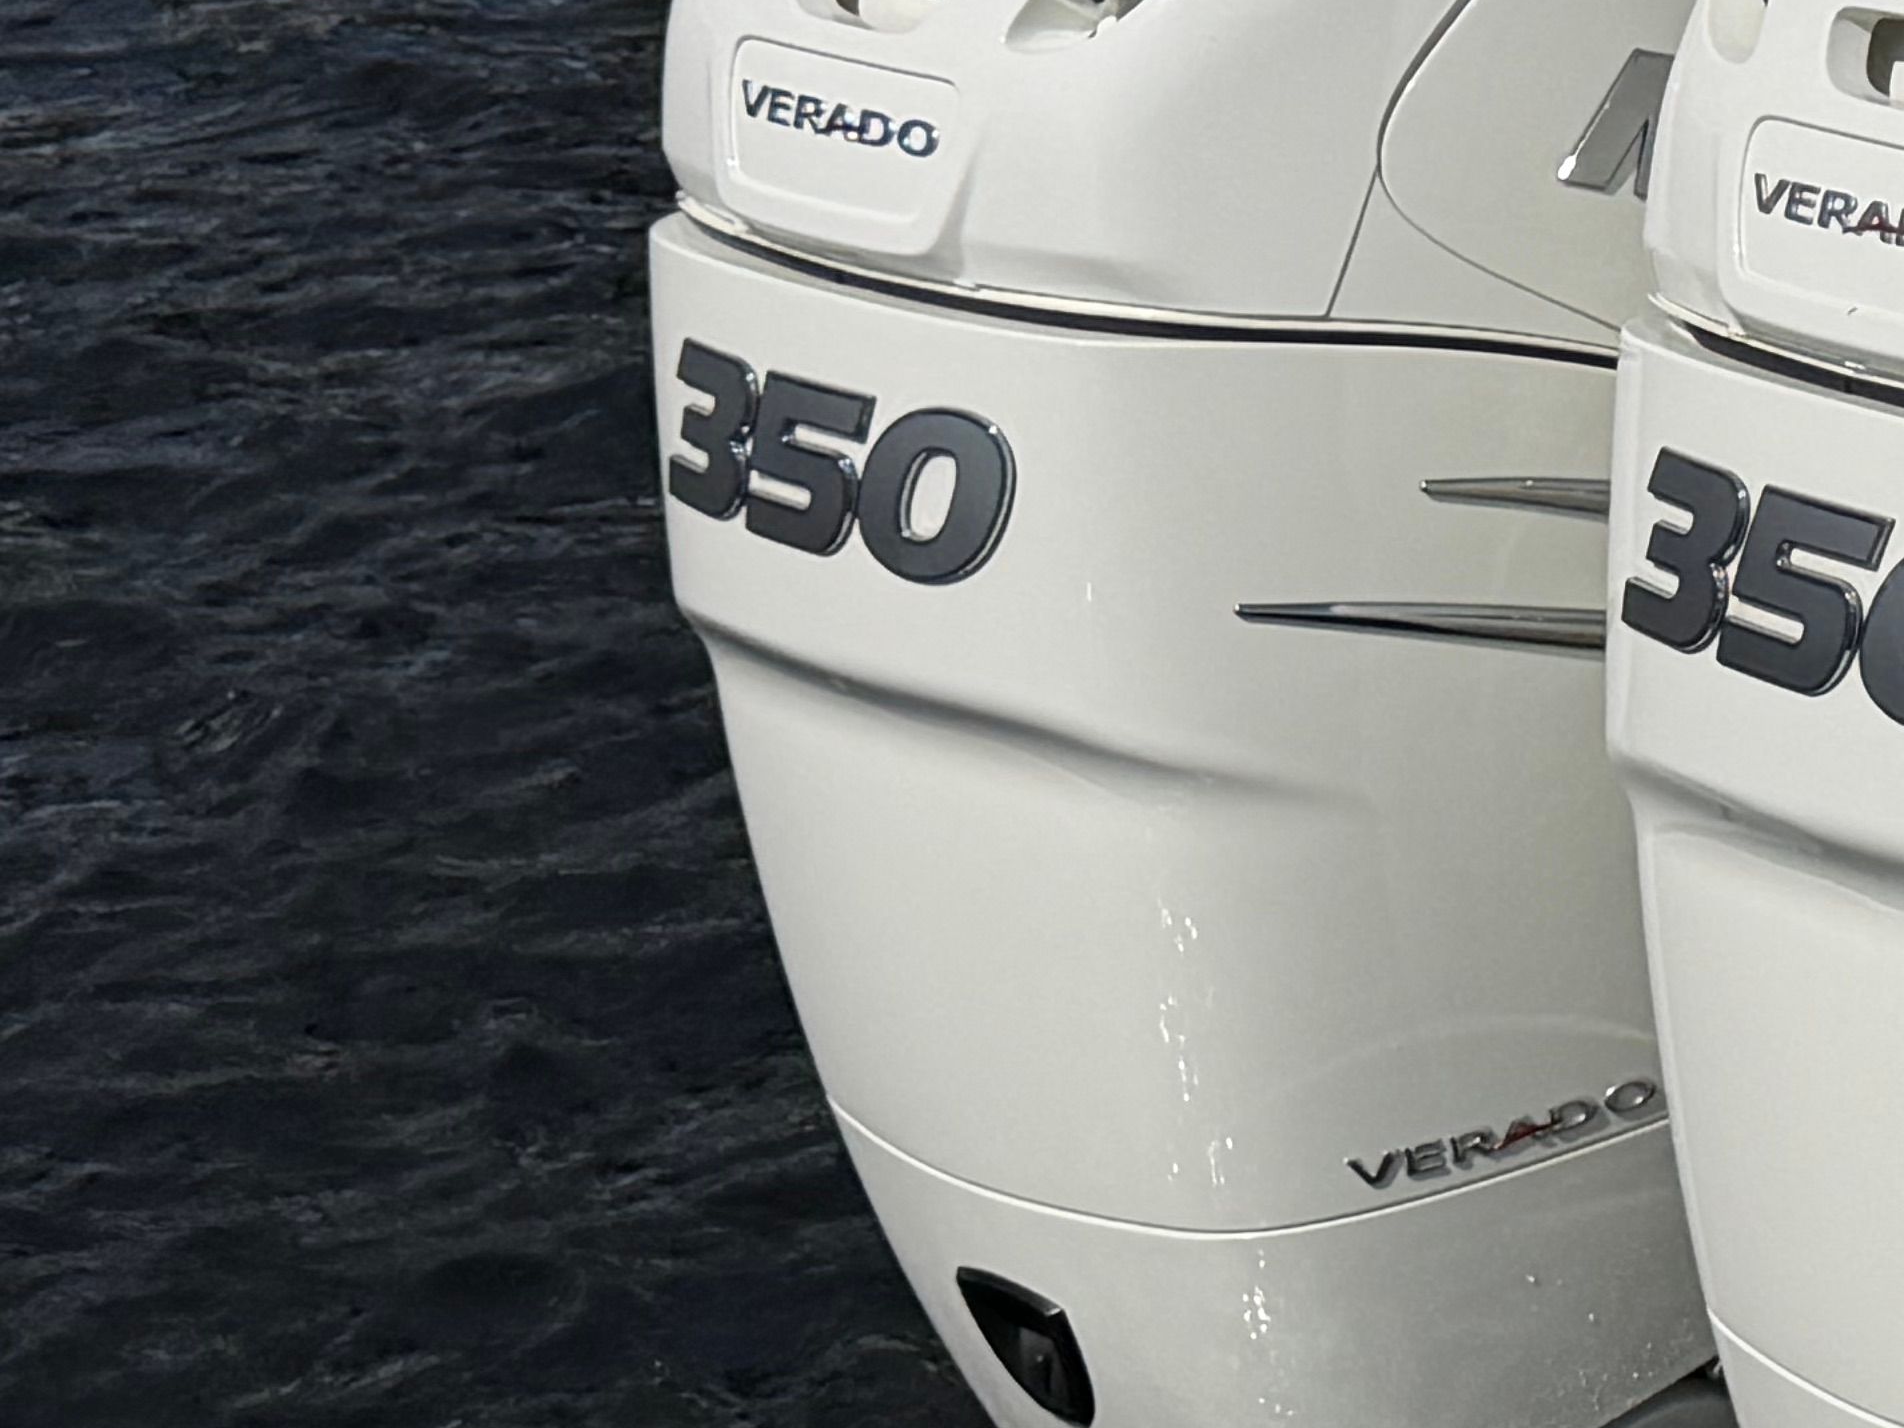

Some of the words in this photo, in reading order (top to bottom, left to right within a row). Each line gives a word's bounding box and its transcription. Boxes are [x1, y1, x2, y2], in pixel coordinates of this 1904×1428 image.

[742, 78, 941, 158] VERADO
[668, 337, 1018, 586] 350
[1343, 1080, 1657, 1189] VERADO
